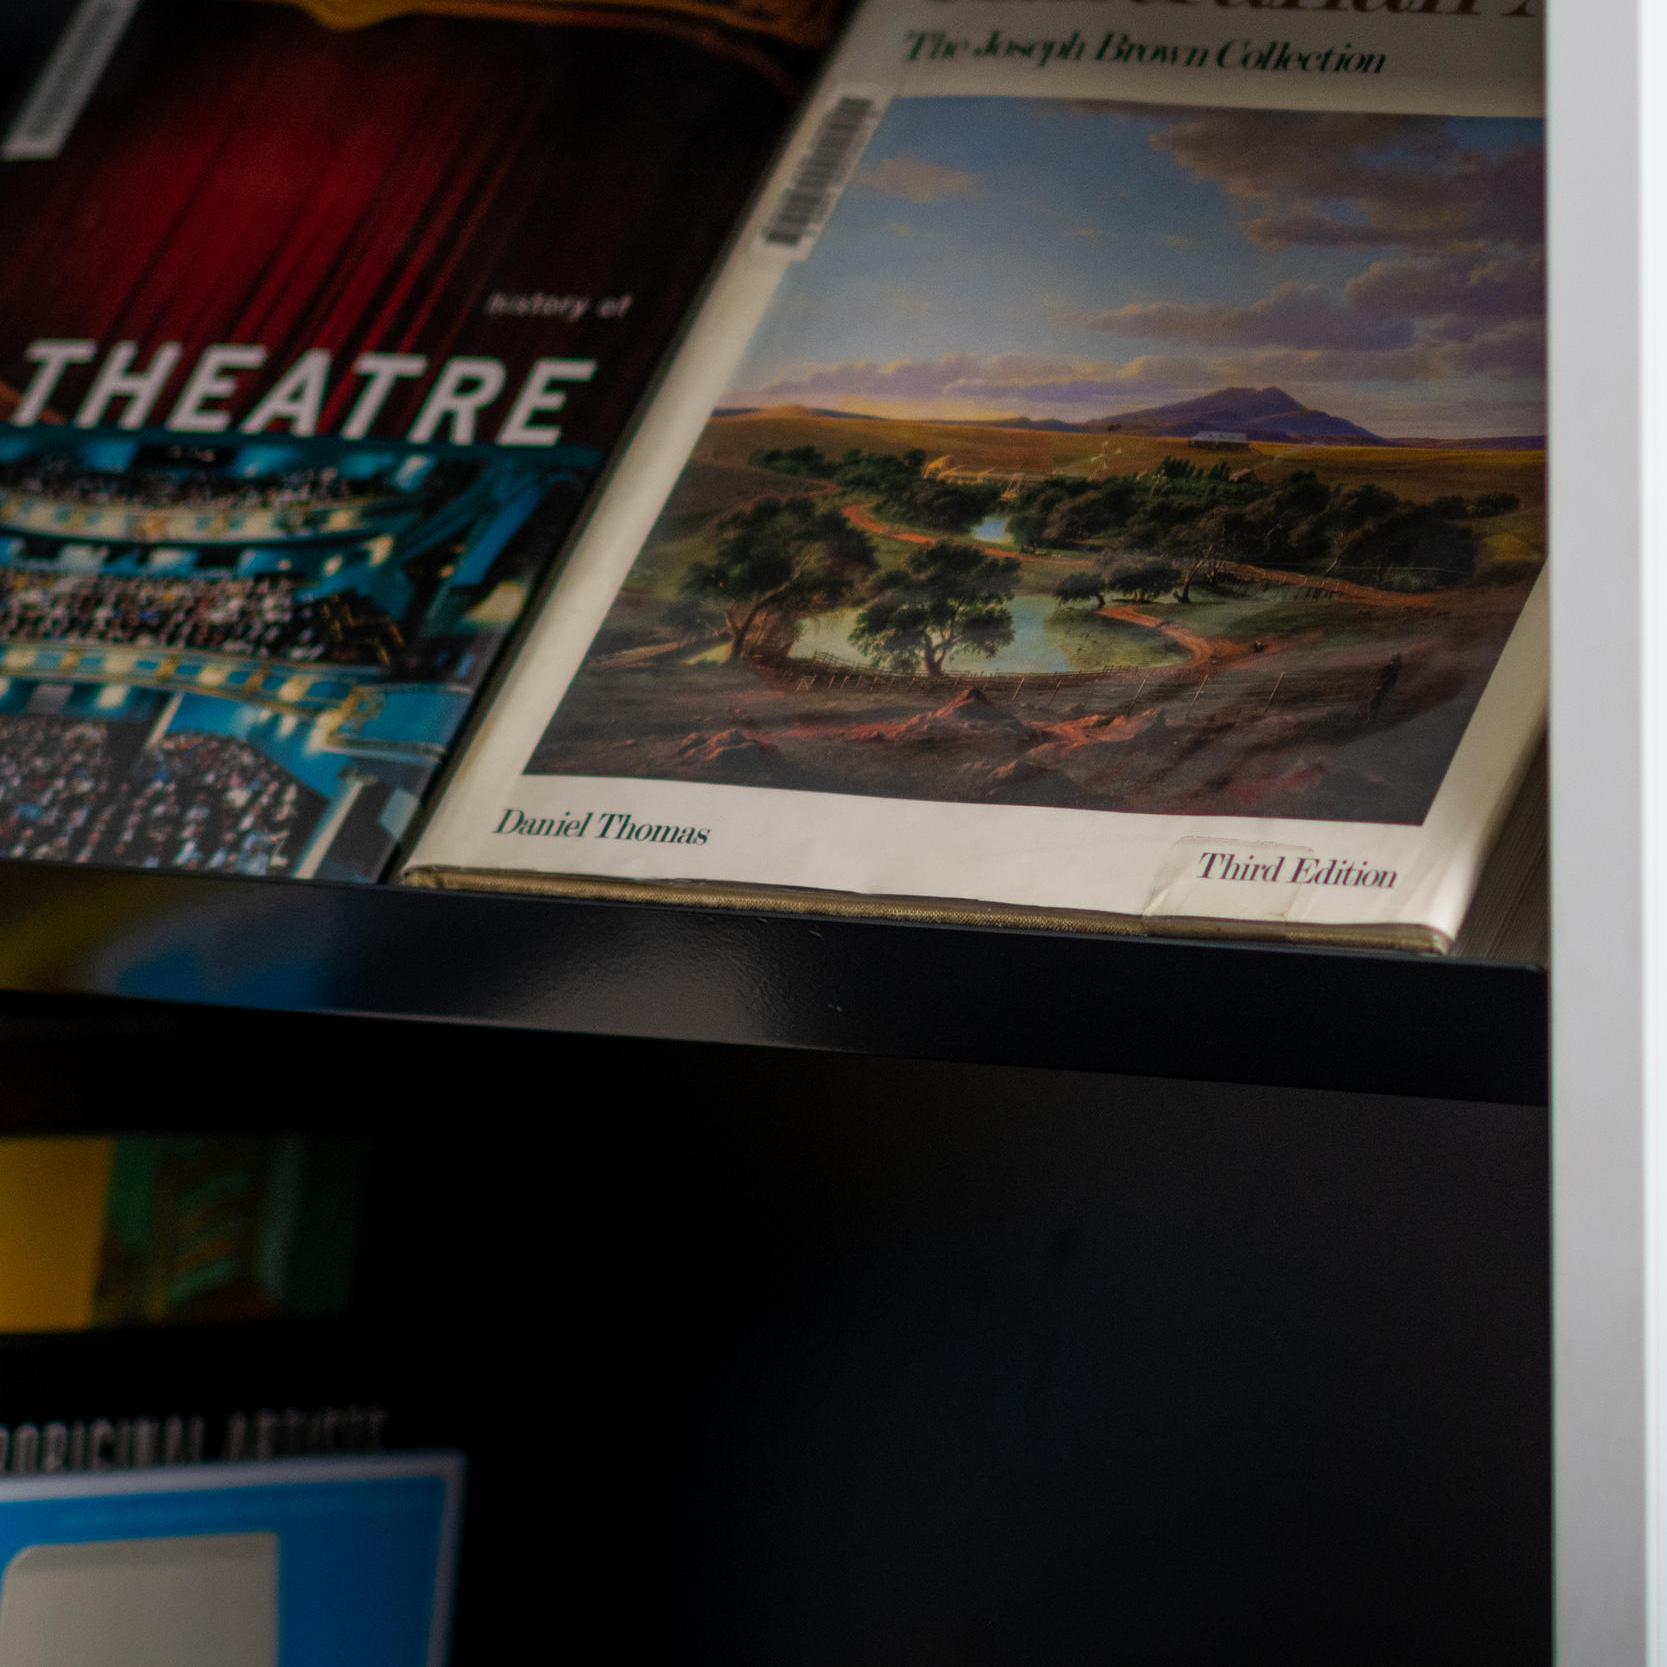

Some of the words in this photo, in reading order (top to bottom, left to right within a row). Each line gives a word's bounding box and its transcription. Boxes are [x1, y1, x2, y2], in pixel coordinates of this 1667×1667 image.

[905, 31, 971, 63] The
[972, 29, 1088, 68] Joseph
[1095, 32, 1209, 70] Brown
[1215, 37, 1388, 75] Collection
[10, 337, 598, 448] THEATRE
[492, 808, 595, 838] Daniel
[593, 812, 712, 846] Thomas
[1195, 851, 1286, 883] Third
[1287, 857, 1399, 889] Edition
